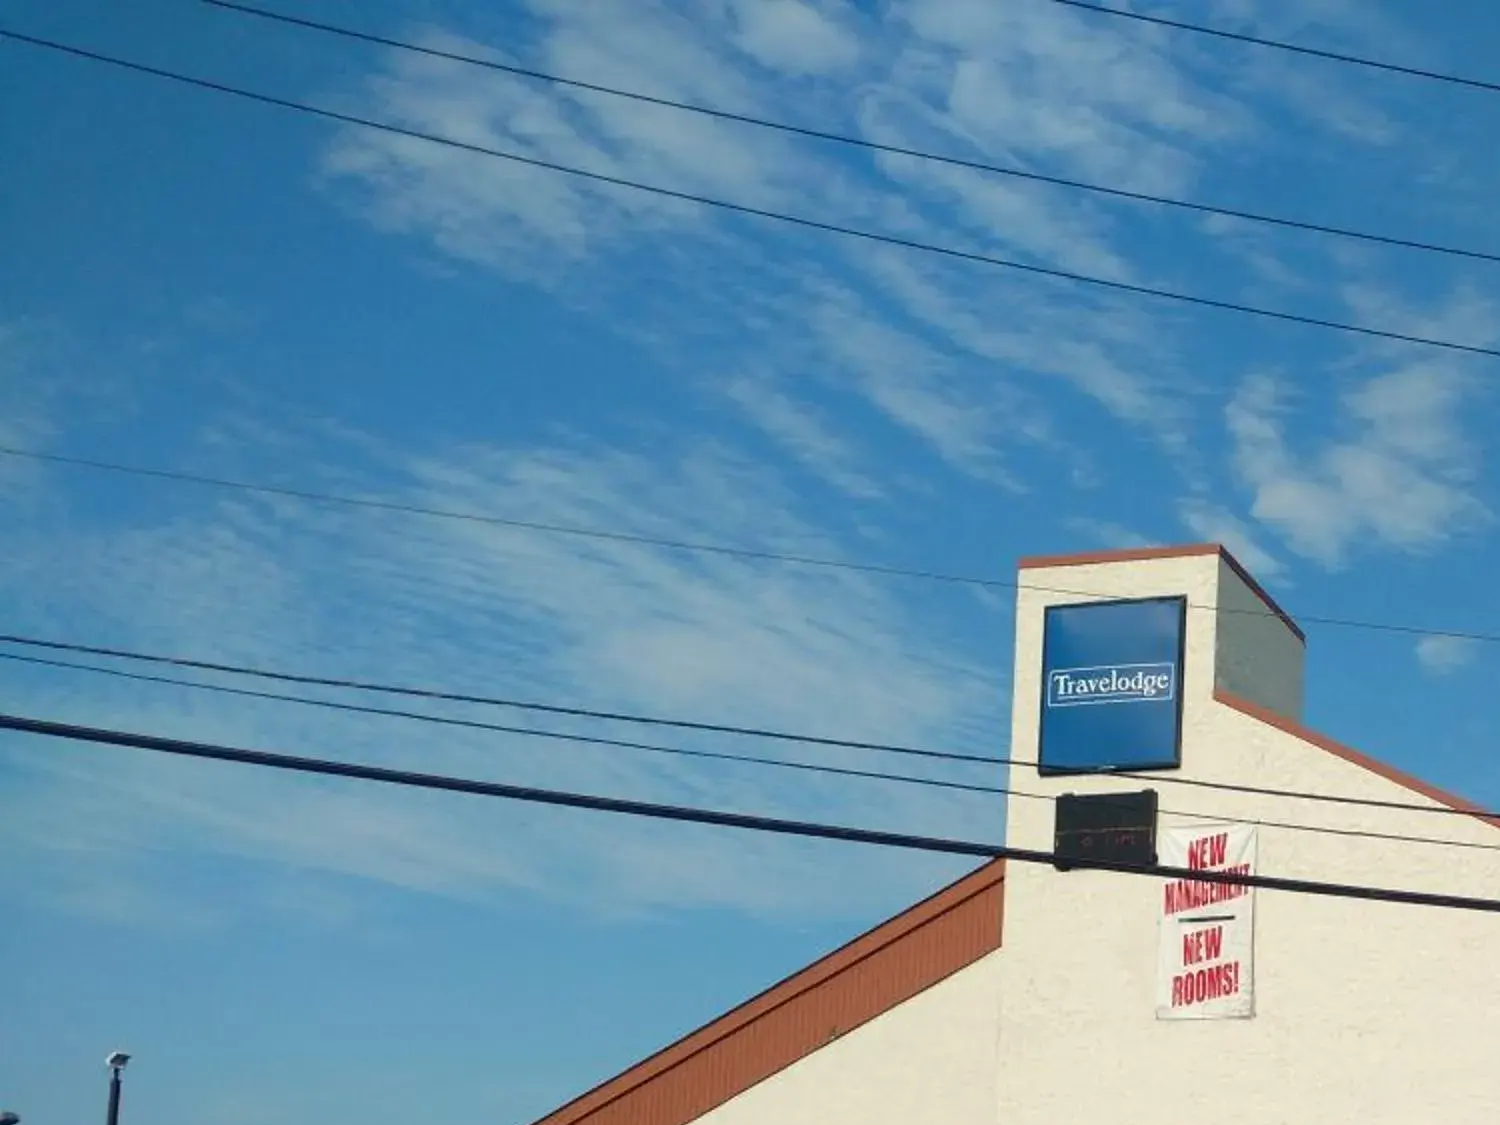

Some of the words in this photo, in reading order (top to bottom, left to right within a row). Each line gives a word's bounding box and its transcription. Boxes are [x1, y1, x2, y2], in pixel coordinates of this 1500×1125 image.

[1053, 669, 1170, 697] Travelodge
[1187, 832, 1228, 871] NEW
[1183, 925, 1223, 966] NEW
[1171, 961, 1240, 1008] ROOMS!
